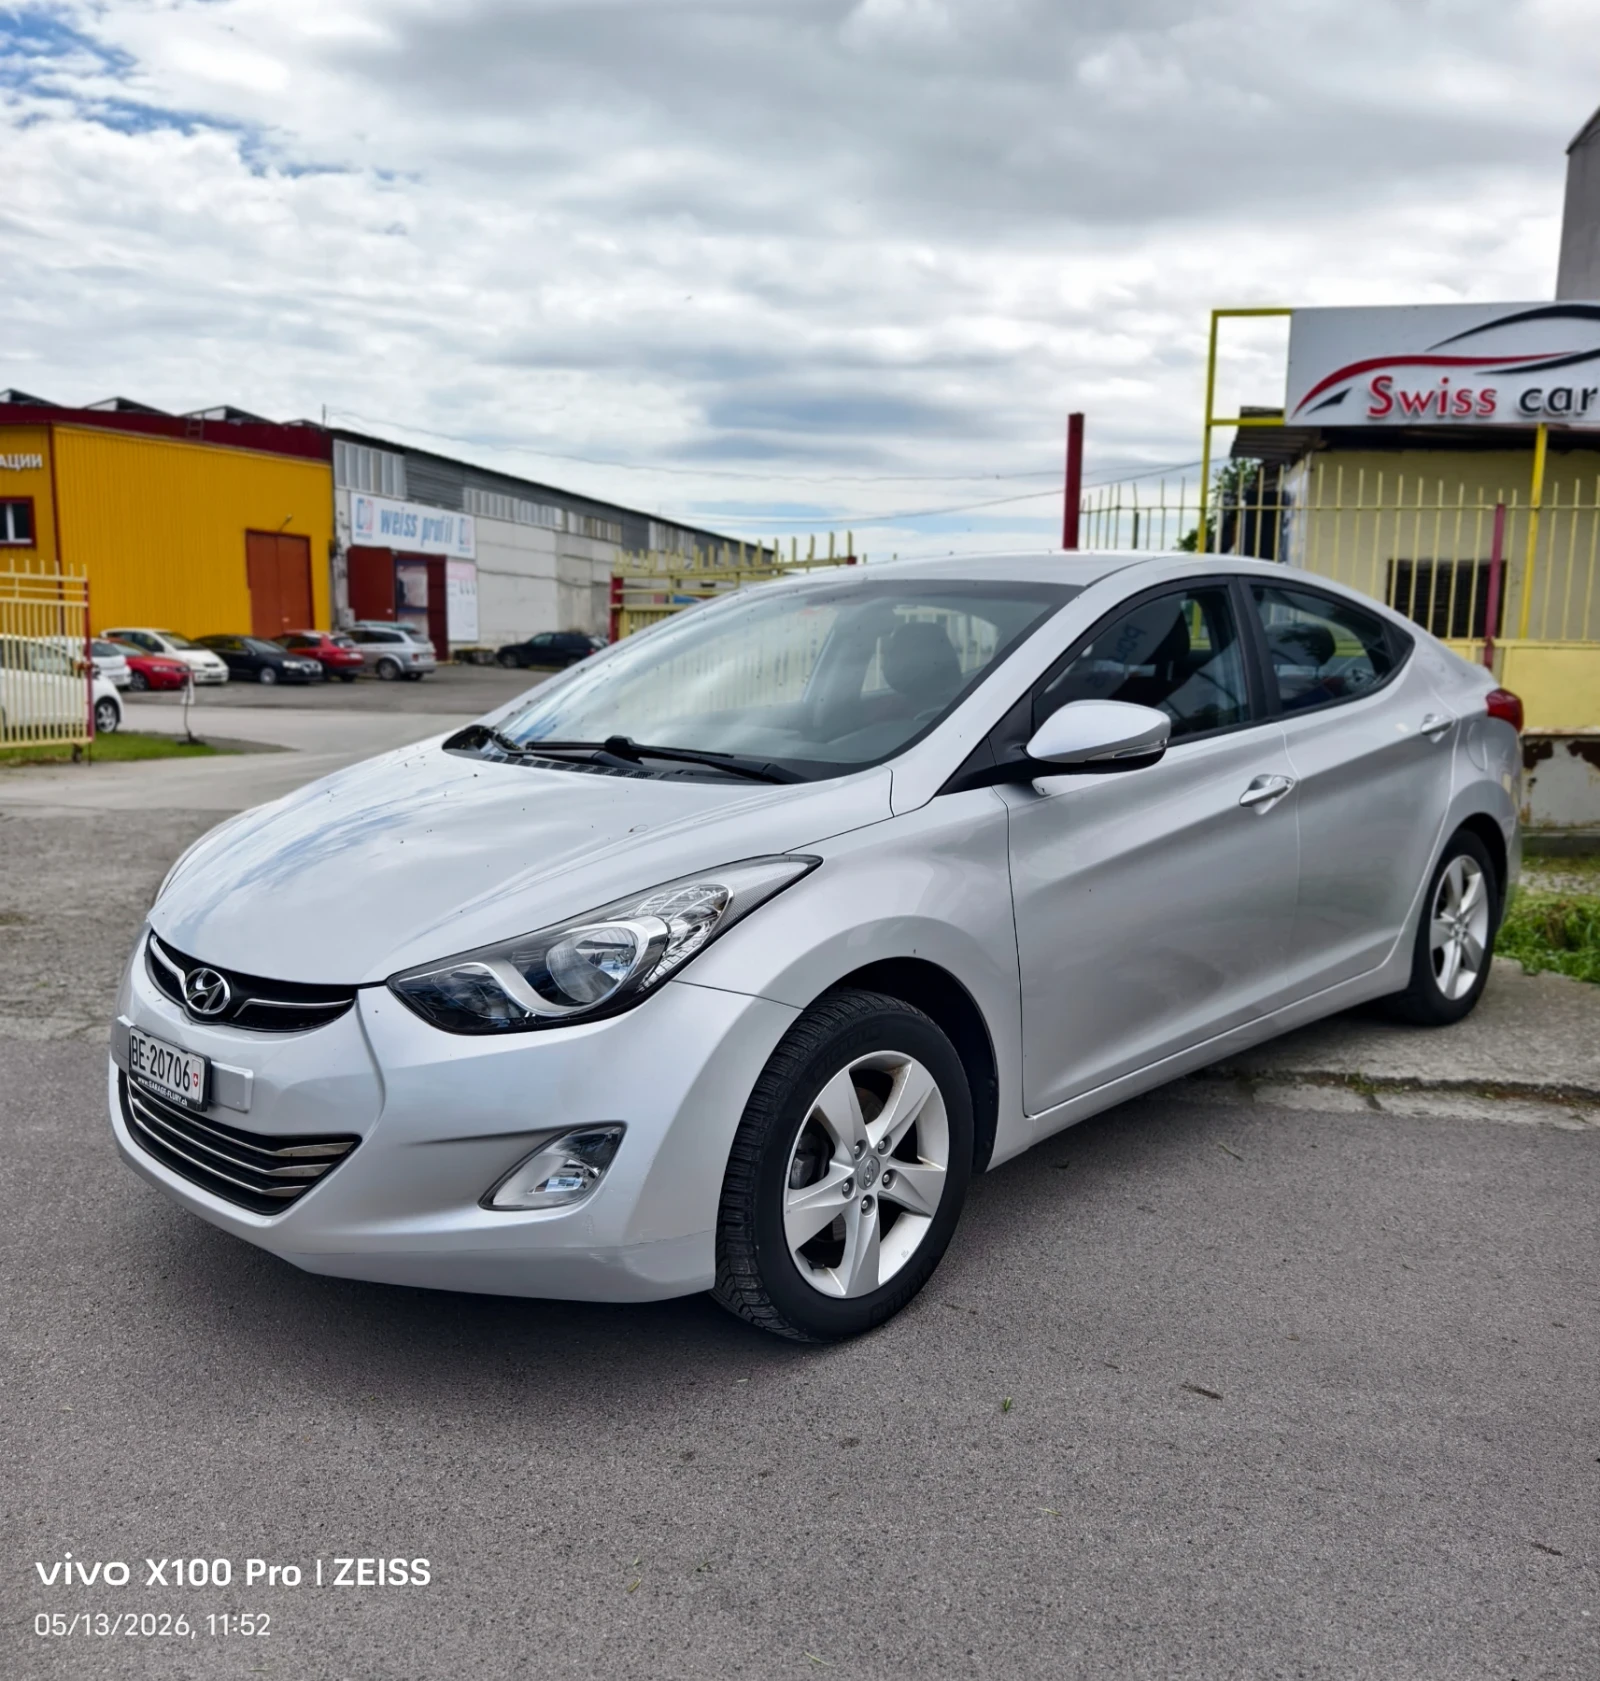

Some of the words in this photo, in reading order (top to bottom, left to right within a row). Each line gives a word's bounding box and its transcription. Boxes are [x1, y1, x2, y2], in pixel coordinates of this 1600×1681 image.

[1367, 375, 1498, 417] Swiss
[1518, 386, 1599, 415] car
[380, 507, 418, 538] weiss
[420, 515, 454, 547] profil
